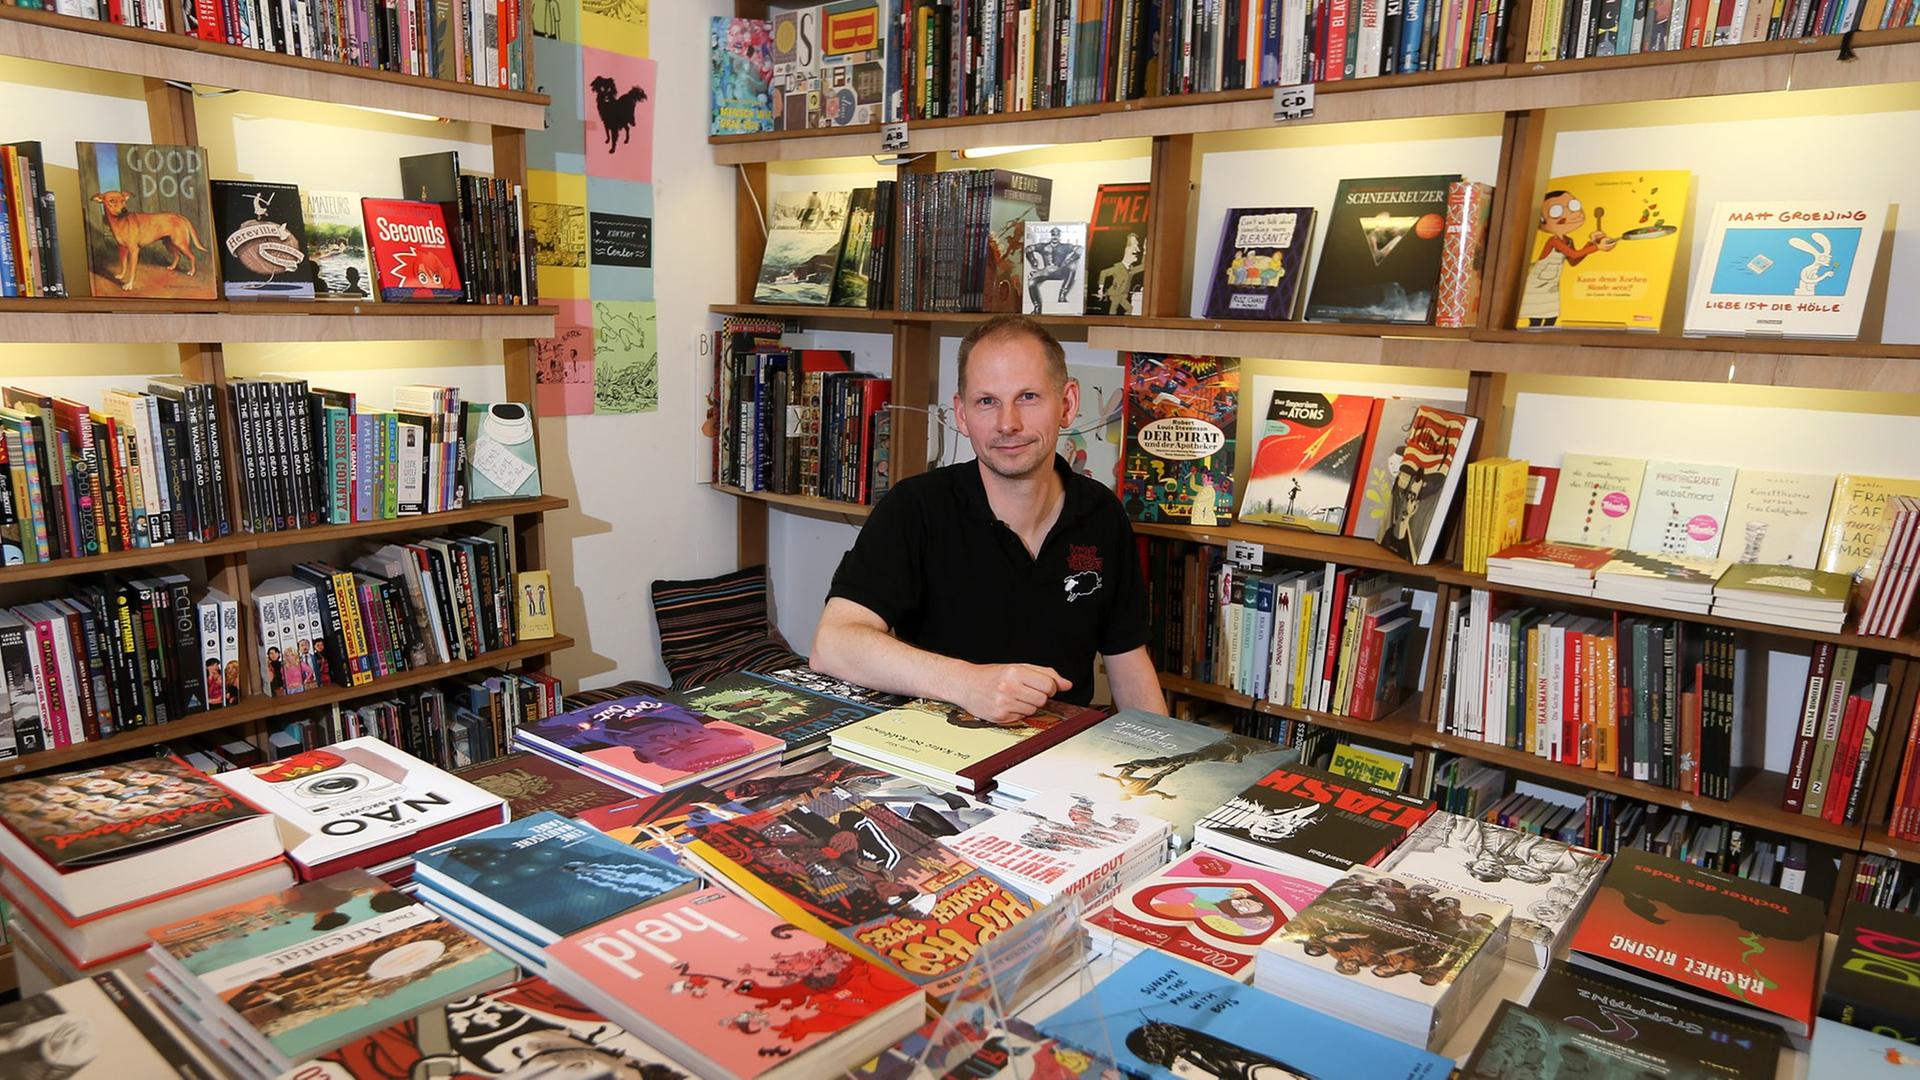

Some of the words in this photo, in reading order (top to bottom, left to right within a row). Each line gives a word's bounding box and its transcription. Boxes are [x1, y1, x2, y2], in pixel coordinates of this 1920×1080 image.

[1330, 34, 1338, 68] CHARLES
[1335, 37, 1343, 64] BURNS
[1281, 96, 1306, 108] C-D
[886, 132, 903, 143] A-B
[126, 146, 201, 174] GOOD
[141, 175, 195, 199] DOG
[1346, 191, 1444, 205] SCHNEEKREUZER
[307, 196, 351, 216] AMATEURS
[1778, 210, 1867, 222] GROENING
[228, 224, 279, 249] Hereville
[376, 216, 446, 245] Seconds
[1238, 232, 1292, 245] PLEASANT?
[1706, 301, 1741, 310] LIEBE
[1771, 303, 1793, 312] DIE
[1797, 302, 1841, 313] HÖLLE
[207, 404, 216, 421] THE
[240, 403, 249, 419] THE
[252, 401, 260, 418] THE
[263, 401, 271, 418] THE
[1288, 409, 1325, 420] ATOMS
[188, 407, 197, 423] THE
[195, 464, 204, 486] DEAD
[210, 422, 219, 458] WALKING
[242, 420, 252, 455] WALKING
[254, 420, 264, 454] WALKING
[265, 419, 275, 453] WALKING
[277, 419, 286, 453] WALKING
[290, 418, 299, 452] WALKING
[300, 418, 308, 451] WALKING
[334, 419, 346, 460] ESSEX
[363, 420, 372, 475] AMERICAN
[1143, 430, 1173, 442] DER
[1176, 431, 1219, 443] PIRAT
[1145, 441, 1159, 449] und
[1161, 441, 1174, 449] der
[1175, 442, 1219, 451] Apotheker
[213, 460, 222, 482] DEAD
[247, 457, 255, 479] DEAD
[258, 456, 266, 478] DEAD
[269, 455, 277, 477] DEAD
[335, 461, 348, 512] COUNTY
[364, 477, 372, 496] ELF
[1235, 551, 1254, 560] E-F
[460, 555, 470, 585] GOOD
[175, 585, 193, 632] ECHO
[326, 593, 336, 610] LOST
[332, 620, 340, 631] SEA
[338, 589, 349, 619] SCOTT
[118, 606, 135, 653] WATCHMEN
[347, 587, 359, 616] SCOTT
[353, 618, 366, 654] PILGRIM
[343, 620, 355, 655] PILGRIM
[1537, 678, 1547, 724] HAARMANN
[1808, 678, 1821, 709] THEODOR
[1830, 680, 1843, 713] THEODOR
[1803, 711, 1815, 736] PUSSEL
[1825, 714, 1836, 739] PUSSEL
[1334, 755, 1397, 782] BOHNEN
[1793, 779, 1800, 788] 1
[1813, 783, 1820, 791] 2
[1257, 769, 1429, 828] CASH
[43, 796, 235, 850] Kinderland
[321, 792, 452, 836] NAO
[528, 818, 566, 833] FABEL
[512, 823, 577, 850] NAUTISCHE
[558, 828, 588, 842] EINE
[1062, 852, 1125, 896] WHITEOUT
[1634, 864, 1682, 883] Todes
[1687, 878, 1718, 891] des
[932, 876, 999, 925] FAMILY
[1721, 888, 1790, 914] Tochter
[389, 911, 417, 926] Das
[969, 888, 1034, 947] HIP
[1108, 914, 1171, 946] Forever
[268, 922, 387, 967] Attentat
[859, 917, 927, 949] TREE
[888, 928, 977, 976] HOP
[1609, 934, 1678, 967] RISING
[1140, 968, 1179, 996] SUNDAY
[1683, 956, 1767, 994] RACHEL
[1155, 989, 1167, 999] IN
[1169, 979, 1188, 993] THE
[1169, 989, 1200, 1006] PARK
[1189, 993, 1218, 1010] WITH
[1210, 998, 1240, 1014] BOYS
